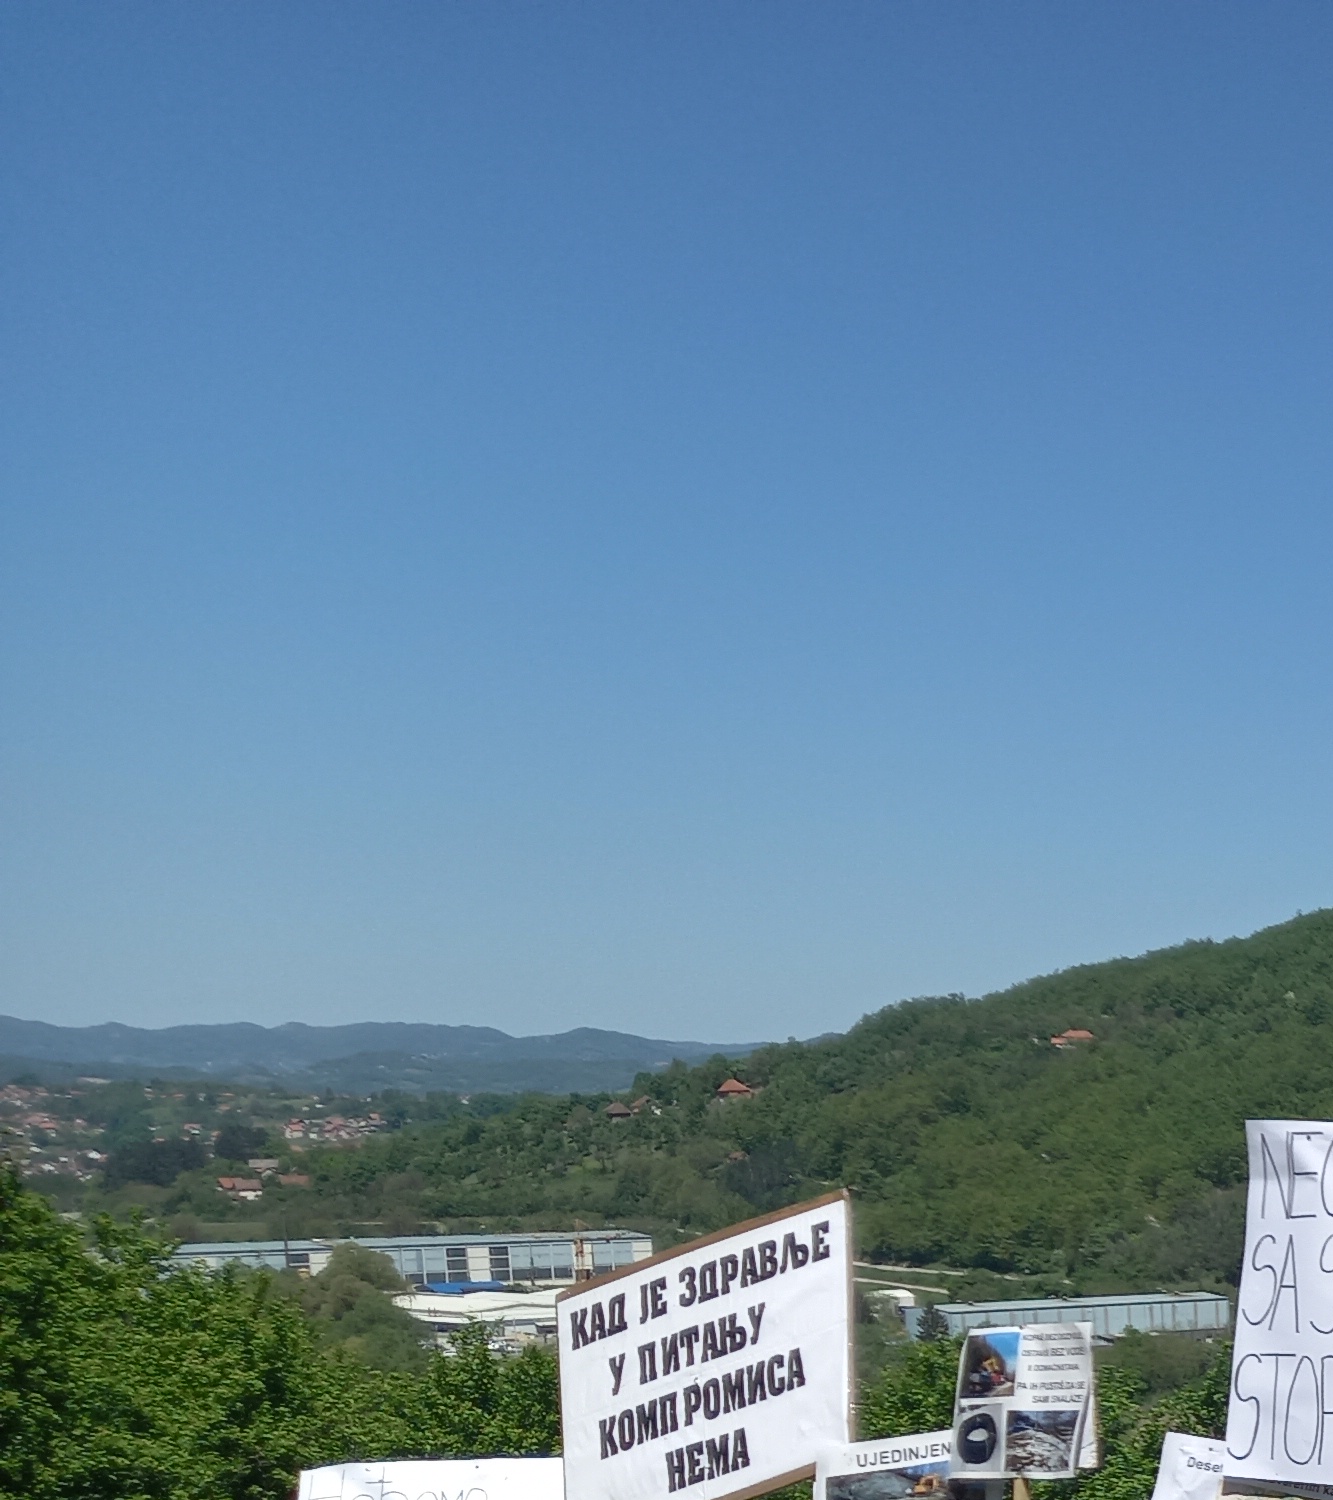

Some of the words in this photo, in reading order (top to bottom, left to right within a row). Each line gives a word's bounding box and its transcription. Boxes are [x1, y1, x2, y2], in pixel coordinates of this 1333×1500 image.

[570, 1292, 628, 1351] КАД
[639, 1276, 668, 1325] ЈЕ
[678, 1220, 830, 1308] ЗДРАВЉЕ
[1241, 1233, 1300, 1333] SA
[608, 1353, 626, 1397] У
[637, 1302, 766, 1386] ПИТАЊУ
[665, 1427, 751, 1494] НЕМА
[856, 1442, 951, 1467] UJEDINJEN
